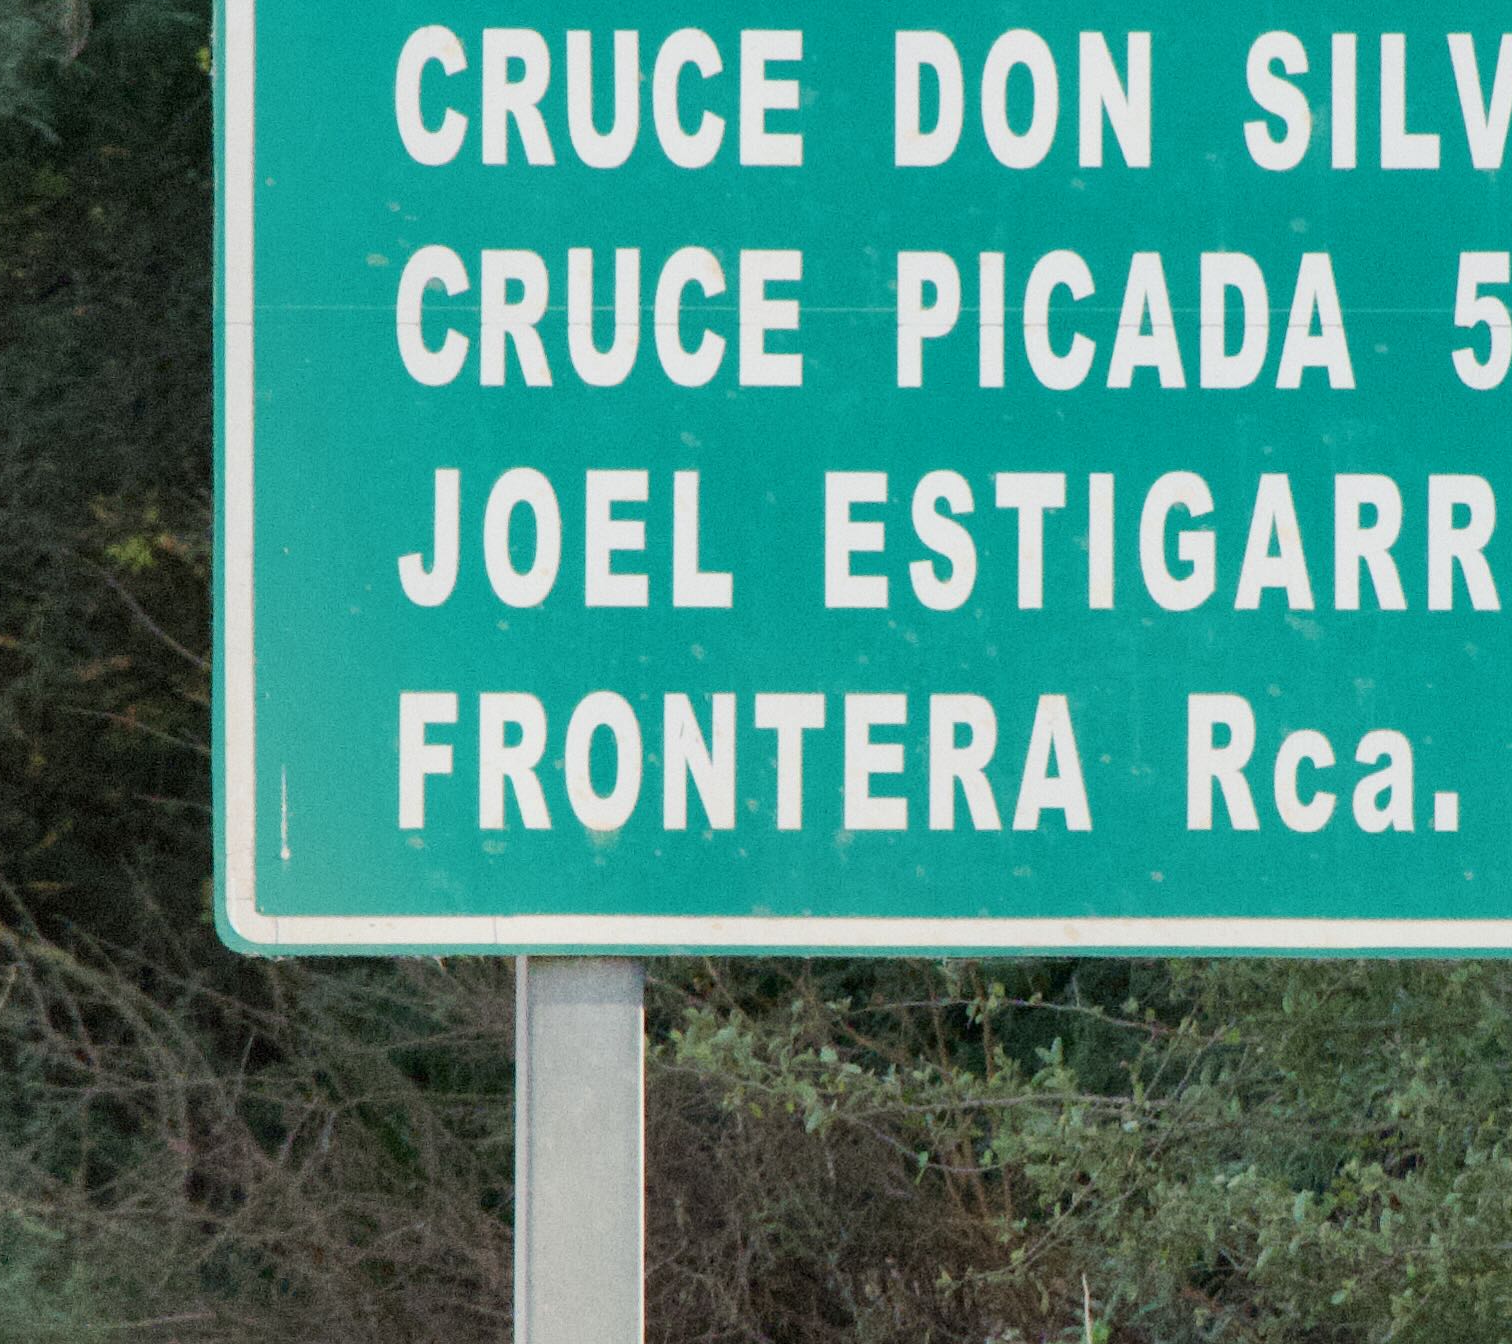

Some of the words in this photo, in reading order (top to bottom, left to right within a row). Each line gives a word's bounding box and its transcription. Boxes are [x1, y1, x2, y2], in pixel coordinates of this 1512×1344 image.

[396, 25, 803, 169] CRUCE
[894, 29, 1151, 169] DON
[396, 245, 803, 388] CRUCE
[897, 248, 1355, 391] PICADA
[398, 467, 733, 609] JOEL
[398, 691, 1092, 834] FRONTERA
[1187, 693, 1459, 834] Rca.
